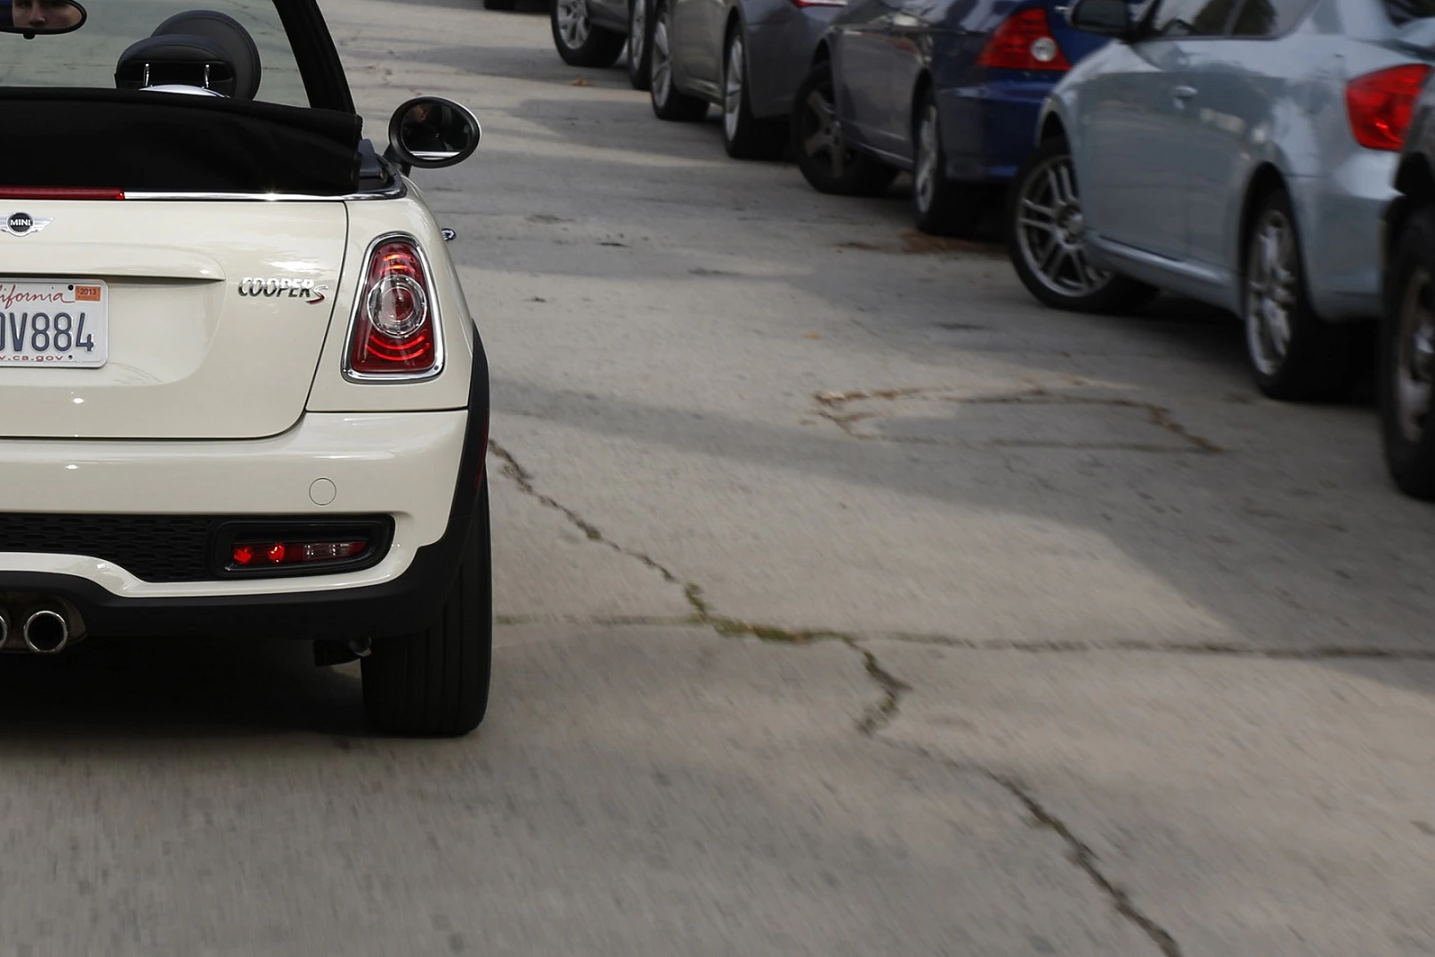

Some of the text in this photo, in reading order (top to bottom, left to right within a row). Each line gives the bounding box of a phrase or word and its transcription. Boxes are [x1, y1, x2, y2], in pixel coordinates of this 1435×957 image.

[10, 218, 31, 226] MINI
[238, 277, 315, 298] COOPER
[80, 288, 97, 296] 2013
